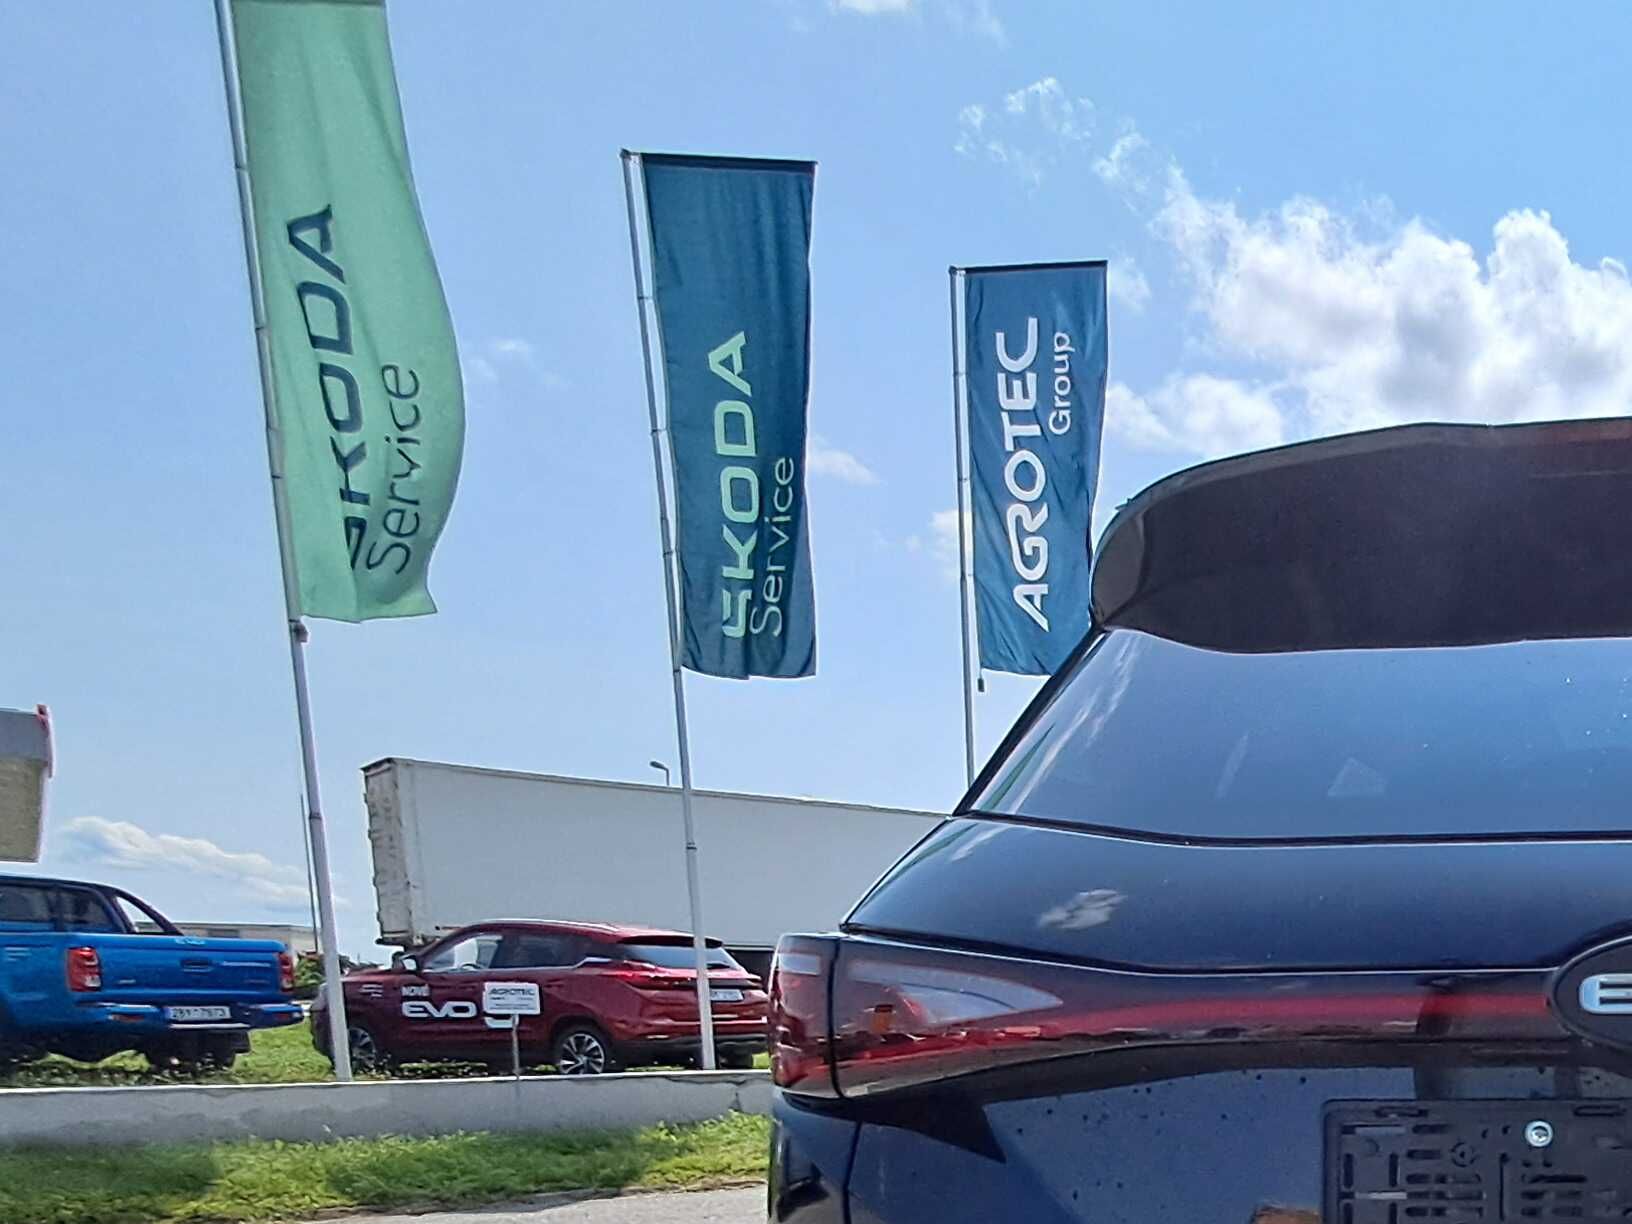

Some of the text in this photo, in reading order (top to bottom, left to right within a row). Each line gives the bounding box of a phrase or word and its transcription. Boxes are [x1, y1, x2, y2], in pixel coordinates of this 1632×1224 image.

[366, 363, 421, 575] Service
[1048, 331, 1075, 436] Group
[750, 456, 794, 636] Service
[996, 316, 1050, 632] AGROTEC
[402, 1001, 477, 1018] EVO
